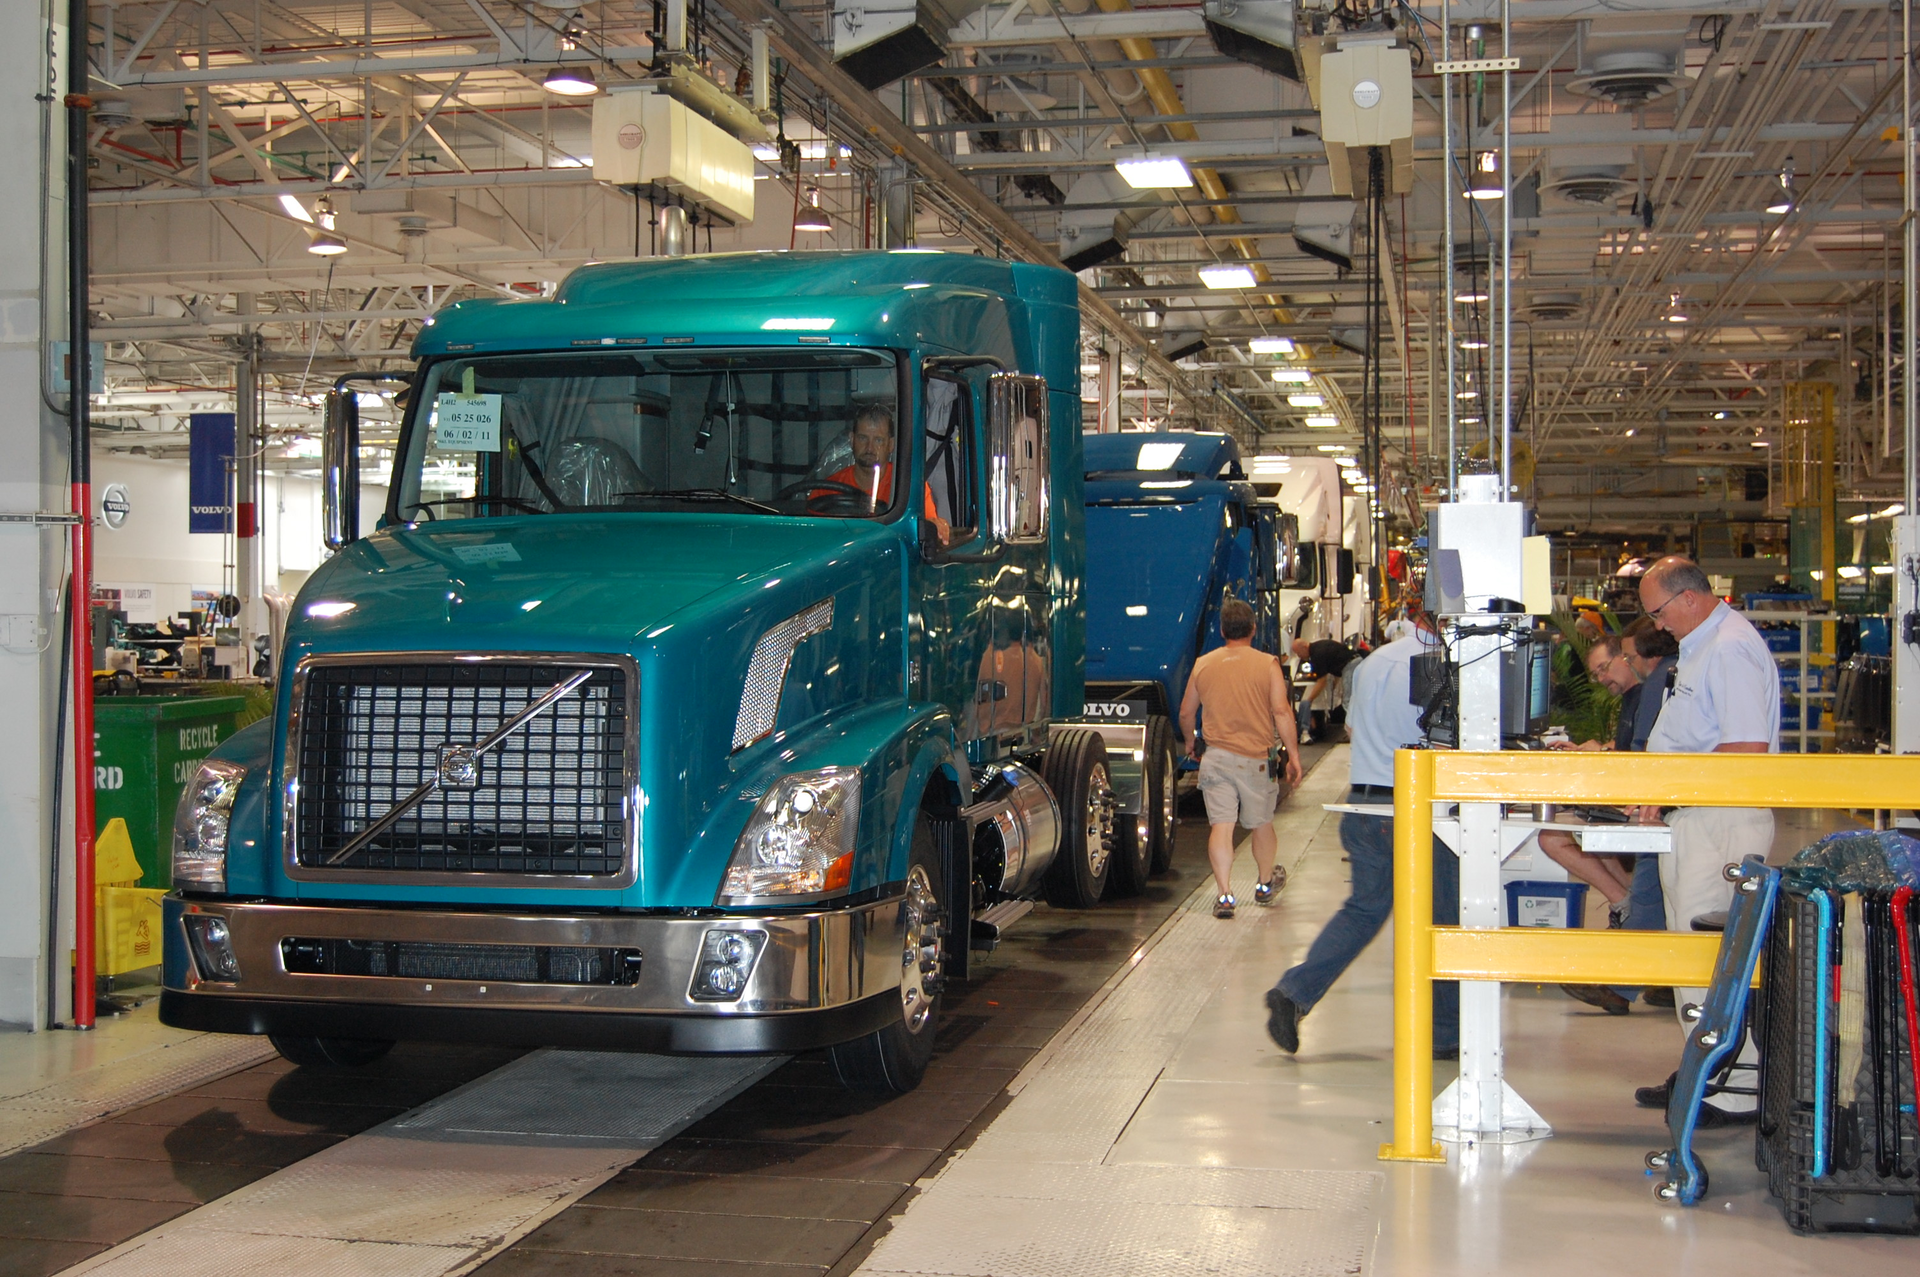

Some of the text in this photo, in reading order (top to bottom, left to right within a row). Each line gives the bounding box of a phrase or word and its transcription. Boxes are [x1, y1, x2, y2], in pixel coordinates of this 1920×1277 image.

[451, 413, 461, 422] 05
[464, 414, 474, 423] 25
[476, 414, 491, 423] 026
[444, 429, 454, 439] 06
[462, 430, 472, 440] 02
[481, 431, 490, 440] 11
[107, 502, 129, 511] VOLVO
[192, 506, 232, 514] VOLVO
[180, 724, 218, 750] RECYCLE
